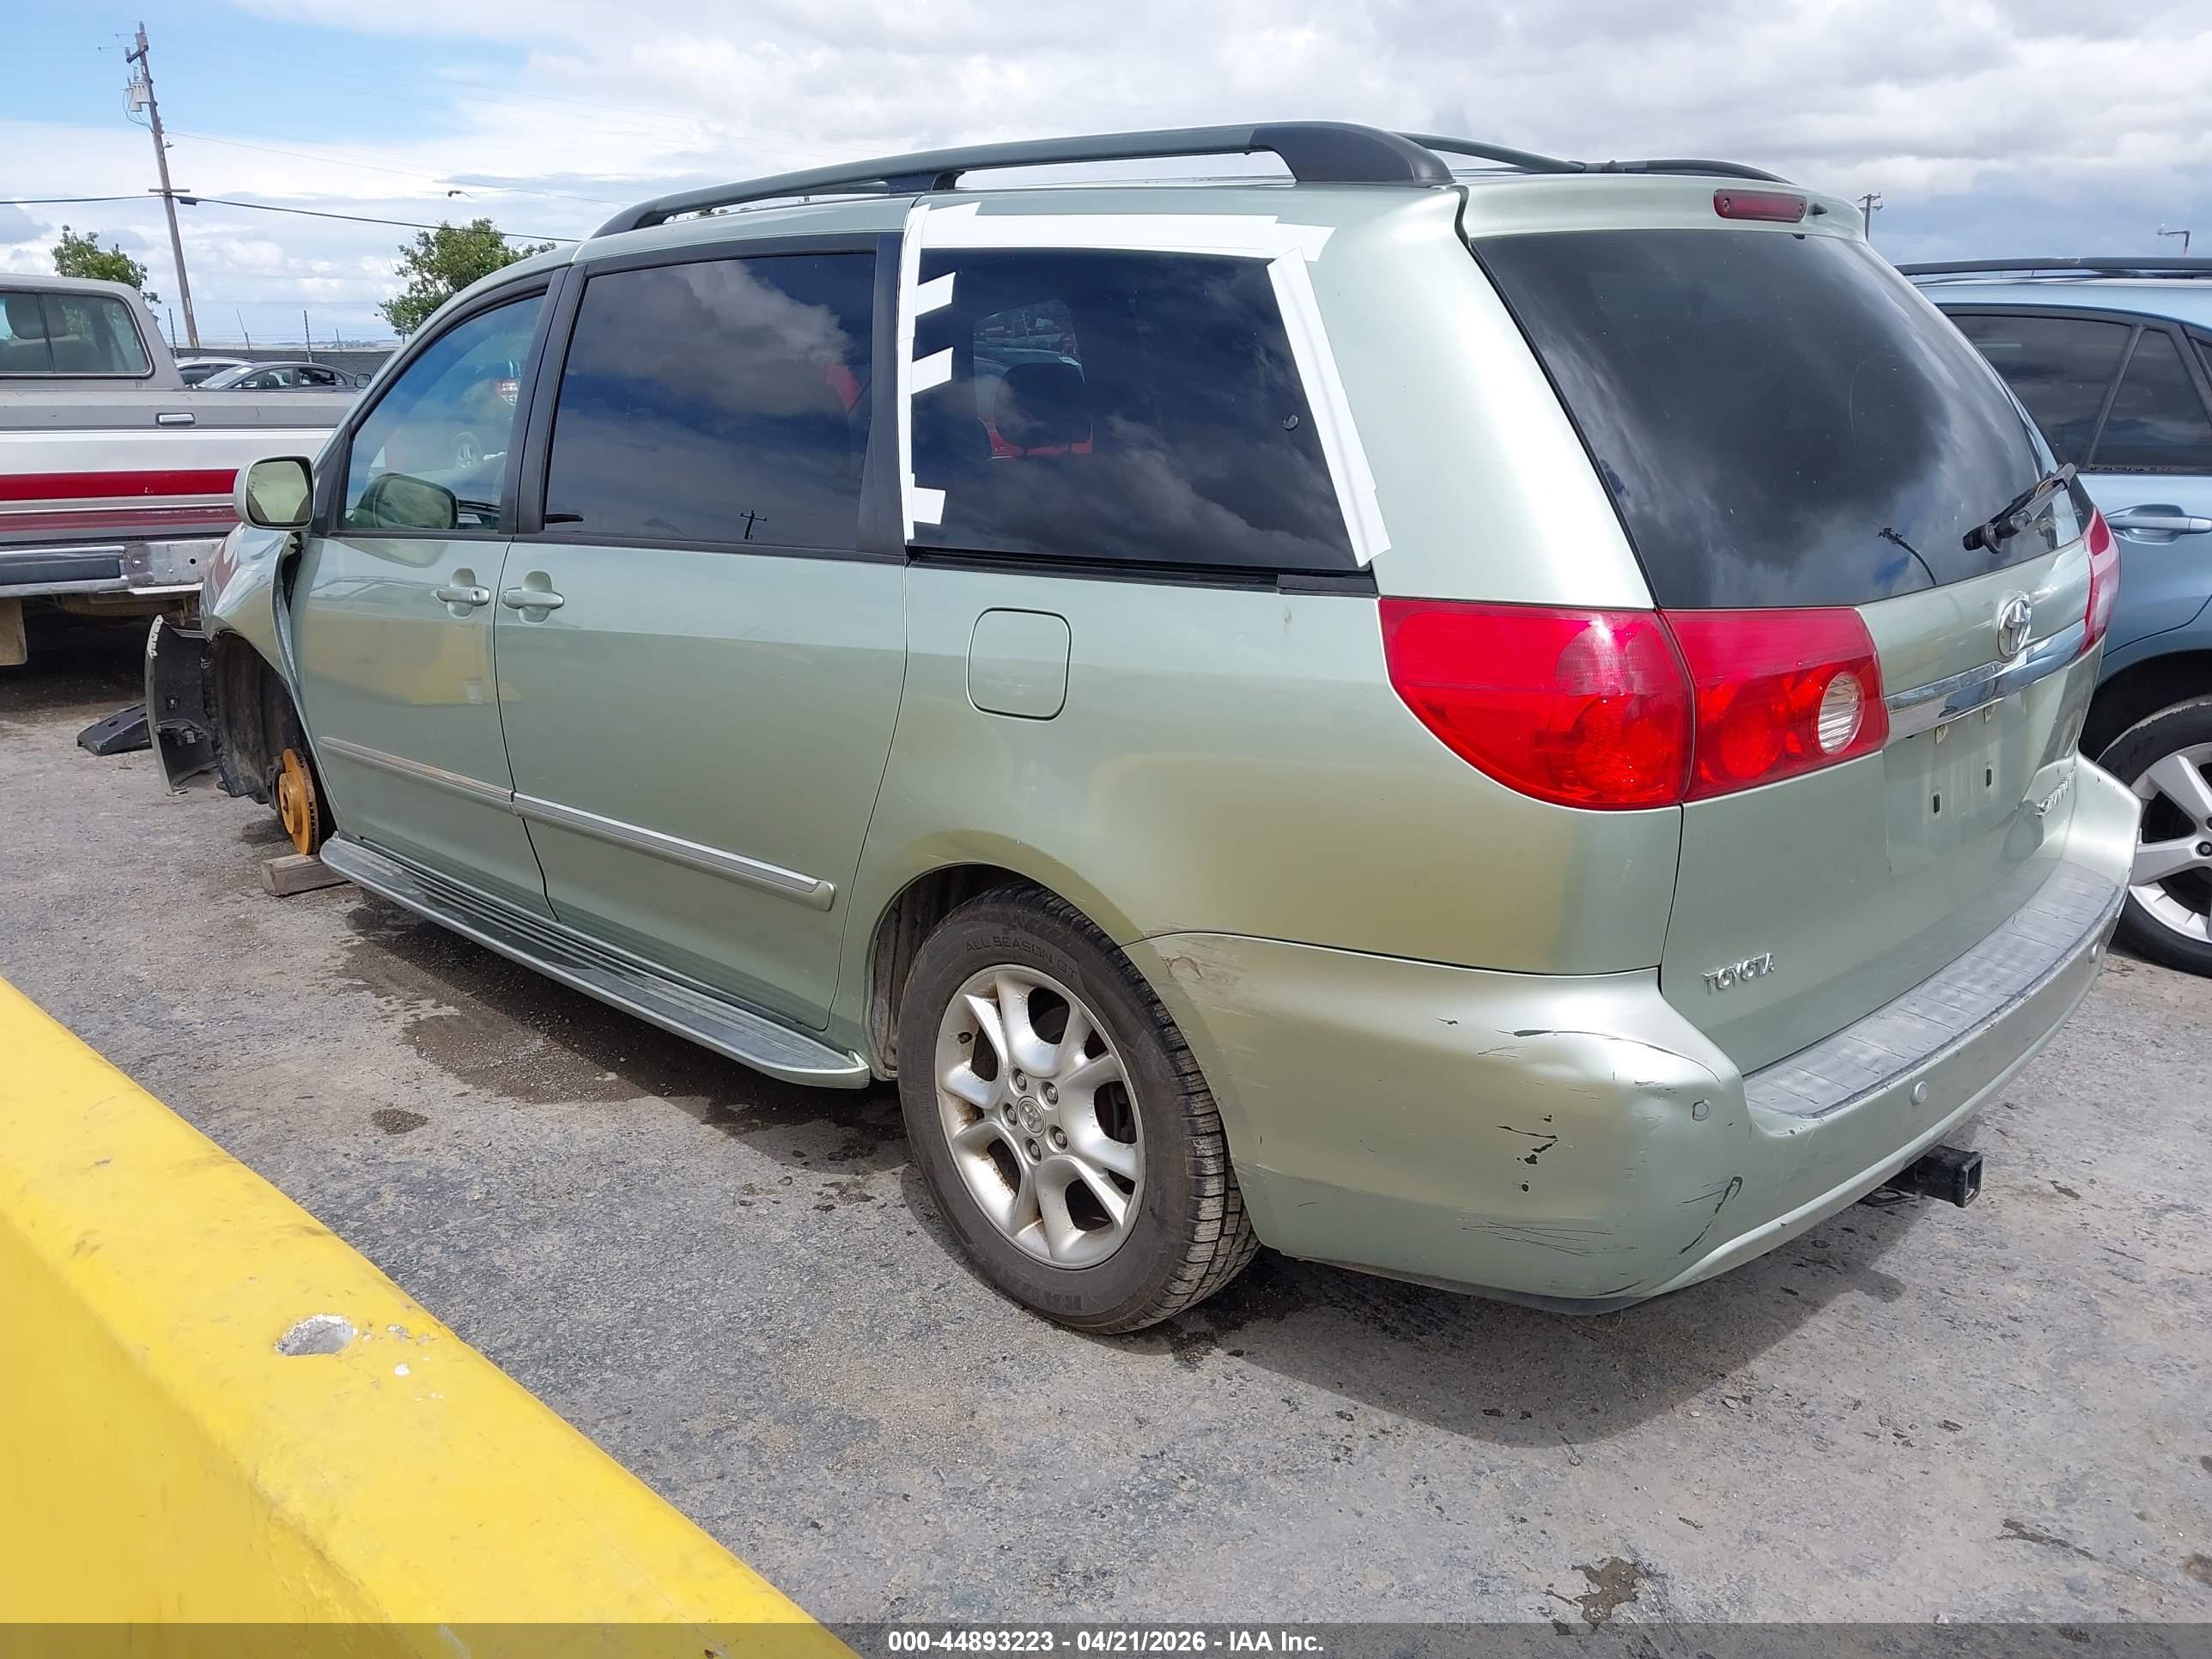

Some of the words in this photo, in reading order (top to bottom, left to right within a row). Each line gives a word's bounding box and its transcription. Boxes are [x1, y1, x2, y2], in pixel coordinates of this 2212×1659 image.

[966, 937, 992, 953] ALL
[992, 936, 1053, 963] SEASON
[1702, 952, 1775, 994] TOYOTA
